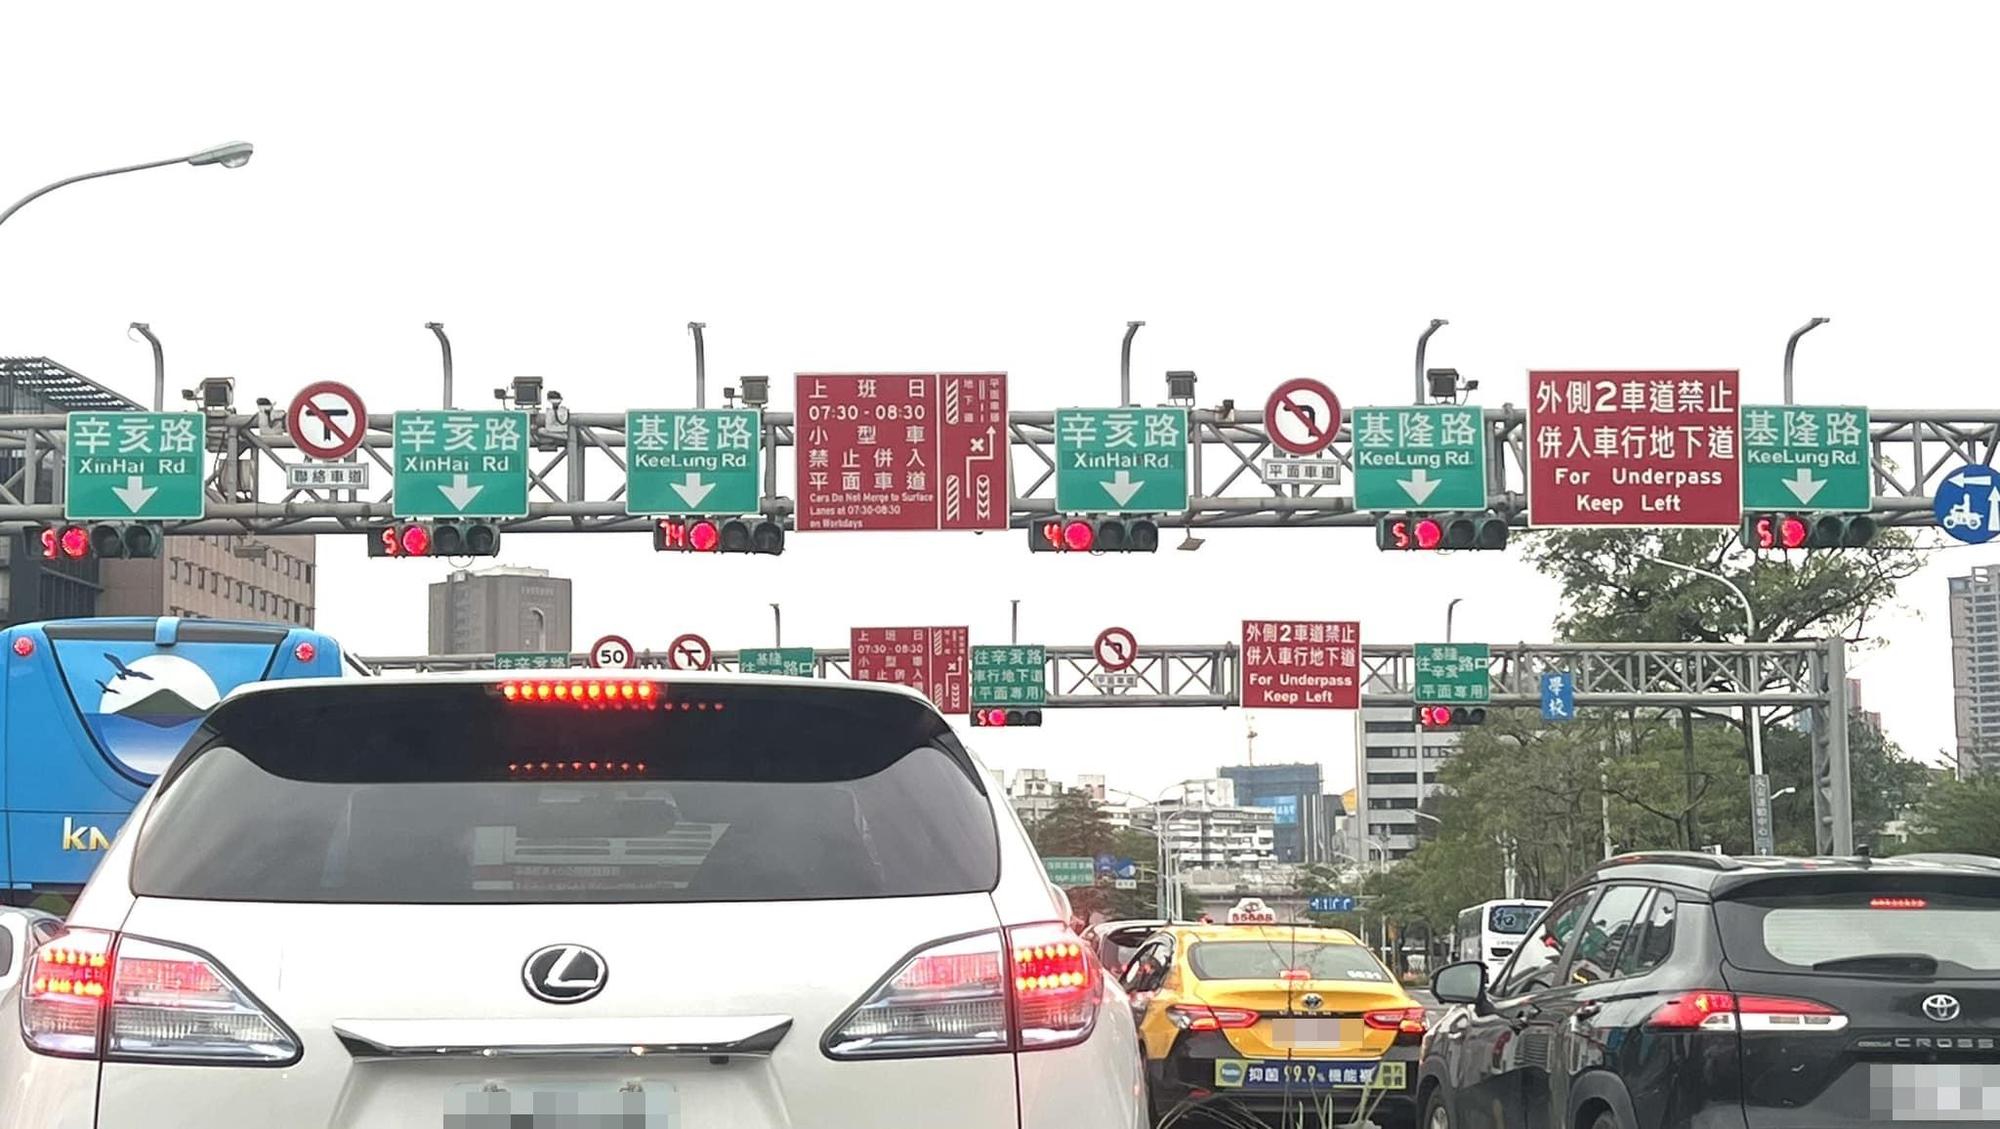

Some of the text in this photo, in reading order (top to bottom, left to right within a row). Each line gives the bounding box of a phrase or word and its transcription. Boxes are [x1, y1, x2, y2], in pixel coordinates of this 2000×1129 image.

[809, 379, 925, 398] 上班日
[1537, 380, 1734, 413] 外側2車道禁止
[809, 405, 858, 421] 07:30
[875, 405, 925, 421] 08:30
[74, 417, 197, 453] 辛亥路
[401, 416, 520, 452] 辛亥路
[633, 415, 752, 451] 基隆路
[809, 425, 925, 445] 小型車
[1061, 413, 1180, 449] 辛亥路
[1359, 412, 1476, 448] 基隆路
[1744, 411, 1861, 447] 基隆路
[1537, 426, 1734, 459] 併入車行地下道
[79, 458, 144, 473] XinHai
[404, 456, 469, 472] XinHai
[636, 454, 717, 470] KeeLung
[809, 448, 925, 468] 禁止併入
[1074, 452, 1137, 468] XinHai
[1360, 451, 1441, 467] KeeLung
[1747, 450, 1829, 467] KeeLung
[1269, 465, 1334, 478] 平面車道
[1555, 468, 1722, 488] For Underpass
[809, 472, 925, 491] 平面車道
[809, 493, 830, 502] Cars
[845, 493, 861, 502] Not
[863, 493, 889, 503] Merge
[901, 493, 933, 502] Surface
[1577, 495, 1681, 514] Keep Left
[809, 506, 835, 515] Lanes
[1247, 623, 1355, 643] 外側2車道禁止
[601, 650, 624, 663] 50
[1247, 646, 1355, 666] 併入車行地下道
[1249, 673, 1352, 688] For Underpass
[1264, 690, 1333, 704] Keep Left
[1895, 1038, 1994, 1048] CROSS
